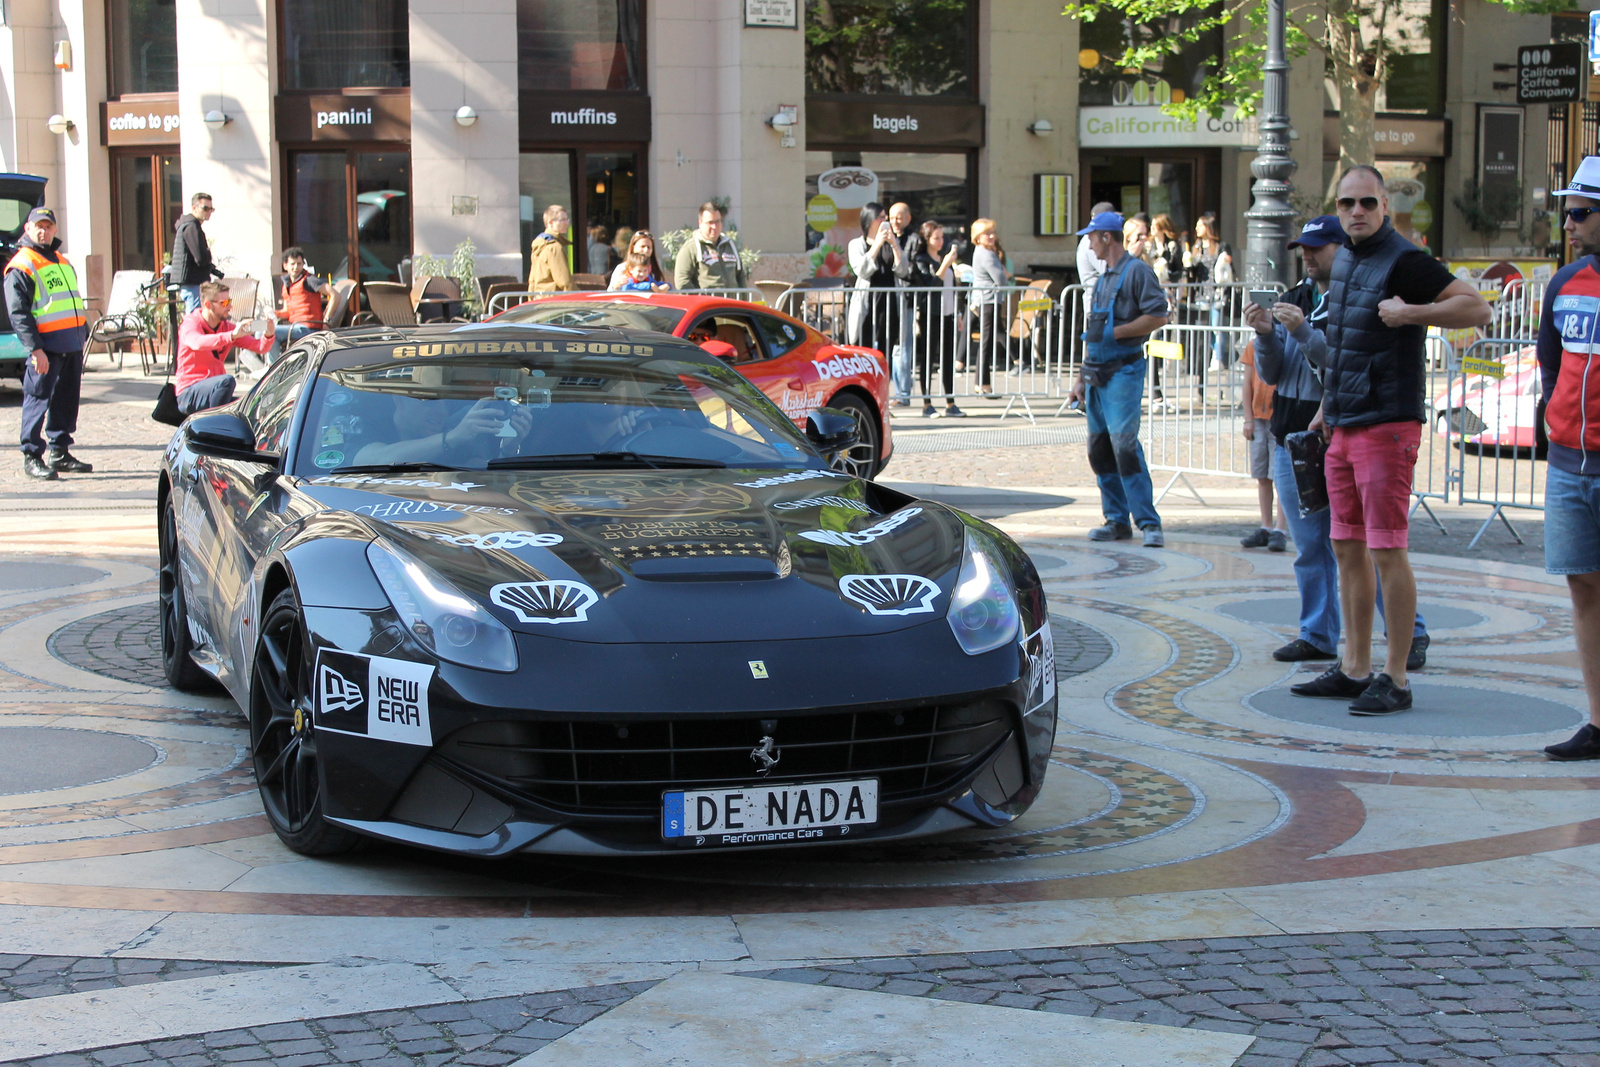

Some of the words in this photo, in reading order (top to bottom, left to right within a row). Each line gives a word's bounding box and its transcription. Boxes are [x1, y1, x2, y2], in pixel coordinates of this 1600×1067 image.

[1521, 65, 1576, 78] California
[1521, 77, 1560, 88] Coffee
[1521, 87, 1575, 99] Company
[109, 113, 147, 131] coffee
[148, 112, 162, 130] to
[163, 114, 180, 132] go
[317, 108, 373, 128] panini
[550, 108, 617, 125] muffins
[873, 113, 919, 134] bagels
[1086, 117, 1198, 135] California
[1388, 129, 1399, 142] to
[1401, 132, 1416, 146] go
[46, 277, 63, 290] 396
[1562, 298, 1580, 309] 1975
[392, 341, 559, 359] GUMBALL
[566, 342, 654, 357] 3000
[811, 352, 873, 381] betsafe
[1464, 361, 1503, 376] profirent
[781, 390, 824, 411] Marshall
[309, 476, 442, 488] betsafe
[602, 521, 699, 532] DUBLIN
[701, 520, 739, 529] TO
[601, 529, 754, 541] BUCHAREST
[377, 675, 419, 703] NEW
[378, 699, 420, 727] ERA
[697, 793, 744, 831] DE
[767, 785, 866, 827] NADA
[670, 820, 678, 830] S
[722, 830, 796, 844] Performance
[797, 828, 824, 840] Cars
